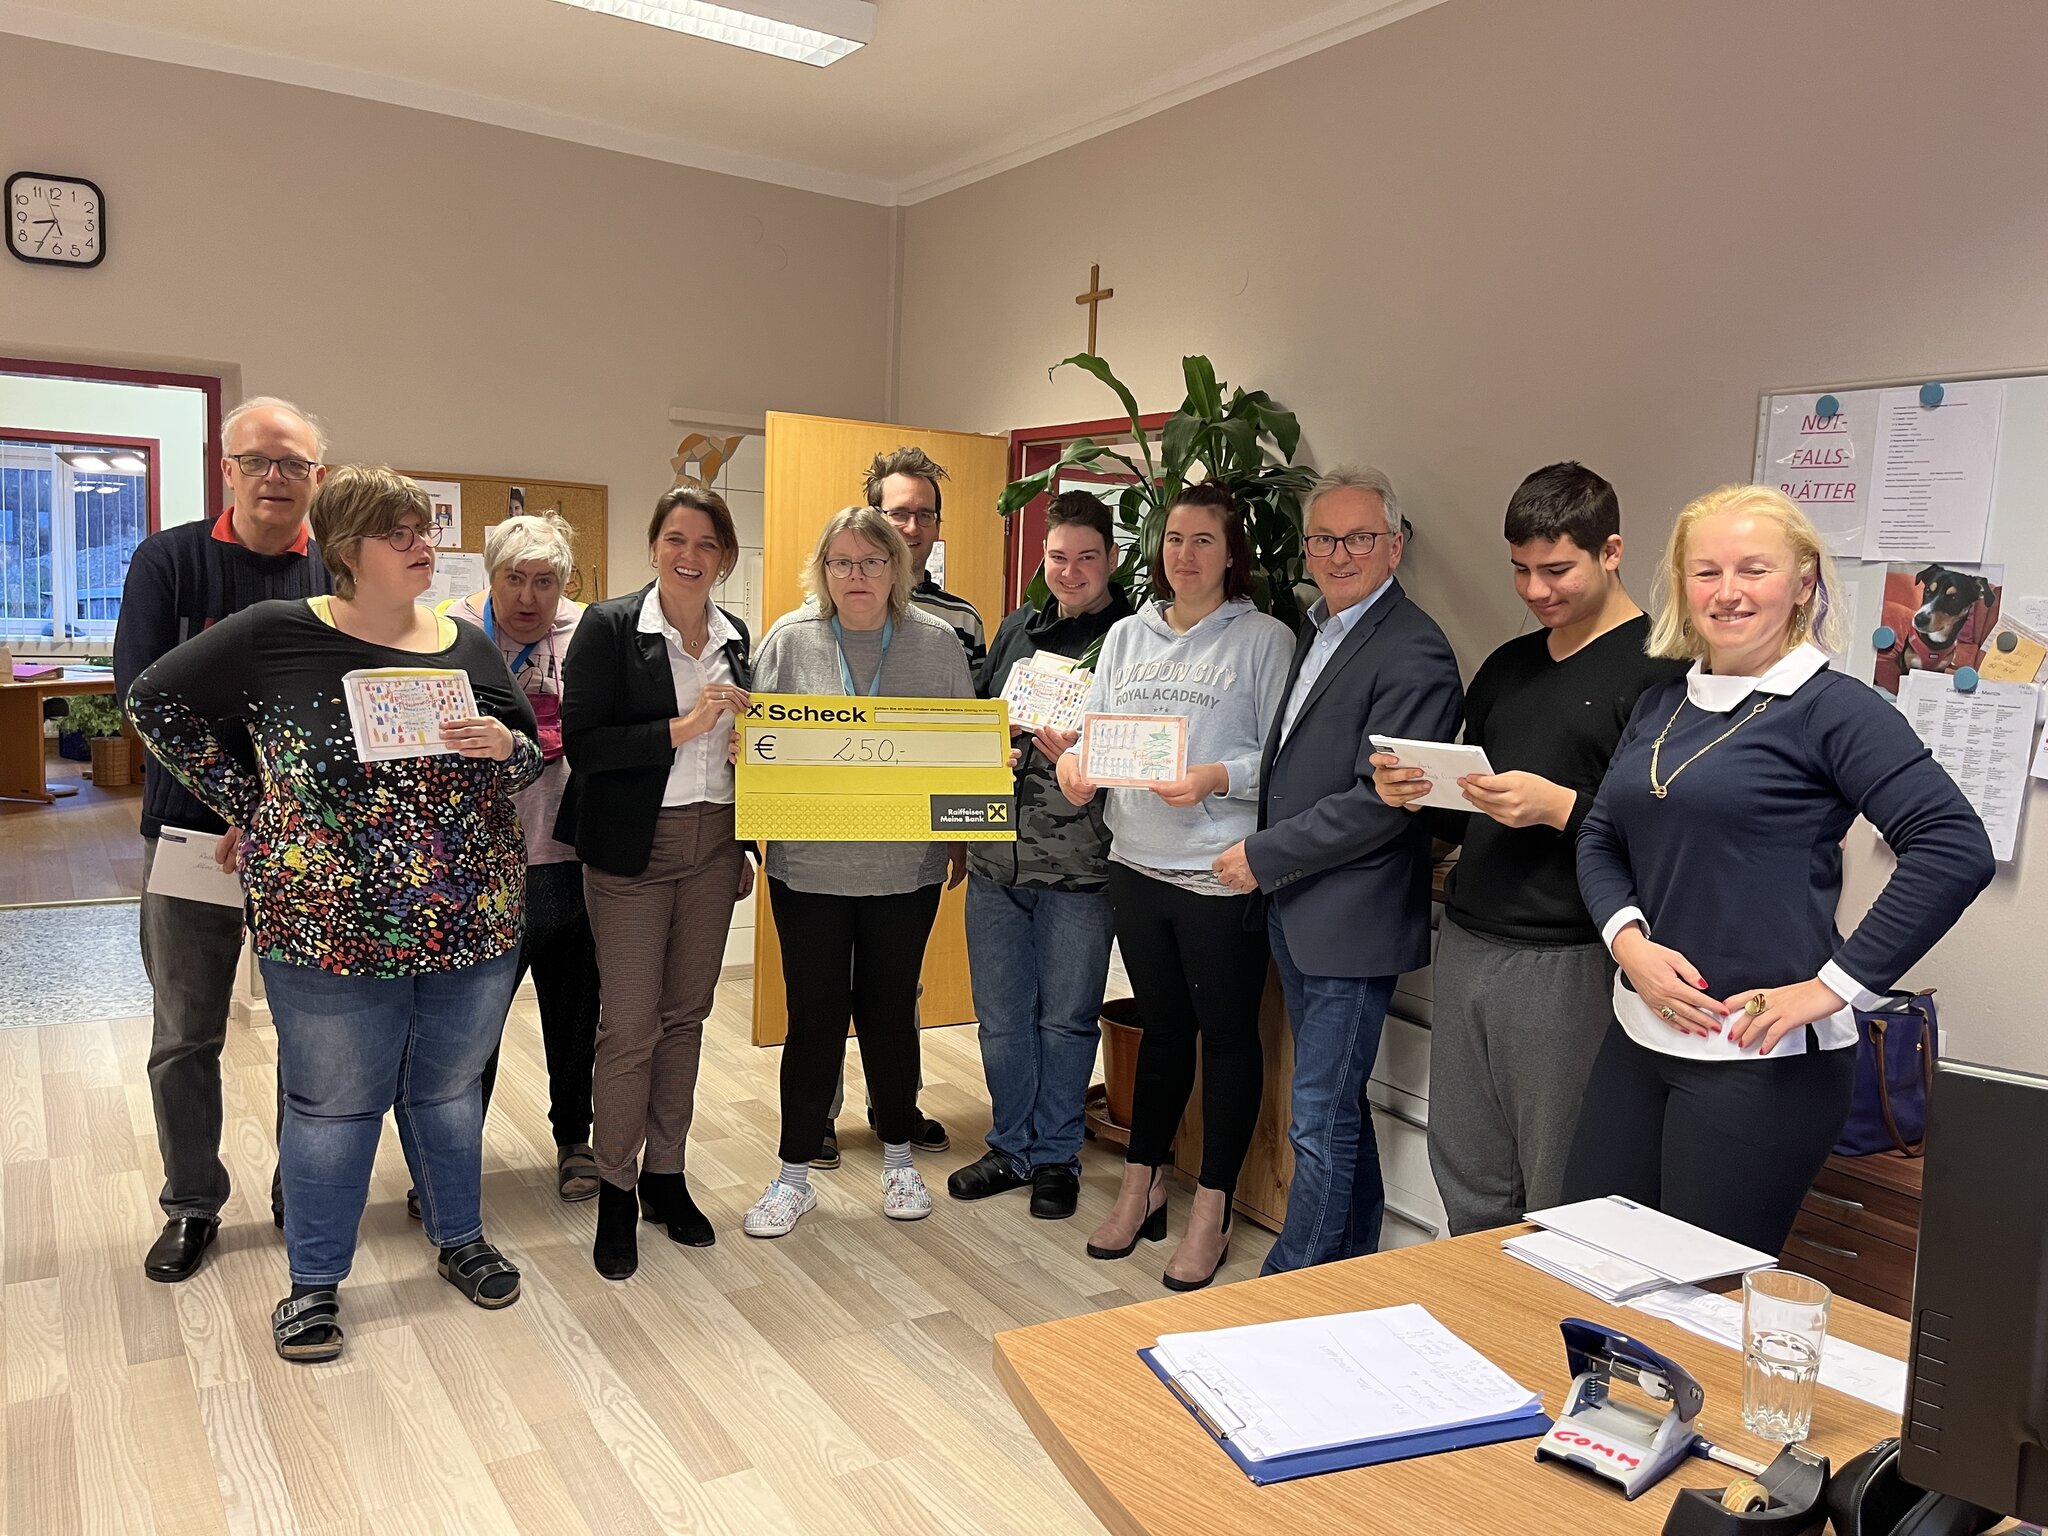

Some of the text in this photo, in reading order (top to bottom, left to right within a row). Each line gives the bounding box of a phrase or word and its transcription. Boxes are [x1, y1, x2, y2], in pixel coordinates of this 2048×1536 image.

[32, 185, 42, 199] 11
[49, 187, 62, 201] 12
[15, 193, 29, 205] 10
[83, 201, 95, 214] 2
[16, 211, 28, 224] 9
[84, 219, 95, 232] 3
[18, 229, 28, 242] 8
[52, 243, 63, 255] 6
[85, 237, 94, 249] 4
[70, 244, 81, 257] 5
[1801, 413, 1848, 431] NOT-
[1791, 448, 1849, 465] FALLS-
[1191, 662, 1238, 692] CITY
[1115, 688, 1220, 710] ROYAL ACADEMY
[768, 704, 867, 723] Scheck
[754, 734, 906, 765] € 250,-
[947, 808, 985, 816] Raiffeisen
[940, 815, 985, 823] Meine Bank
